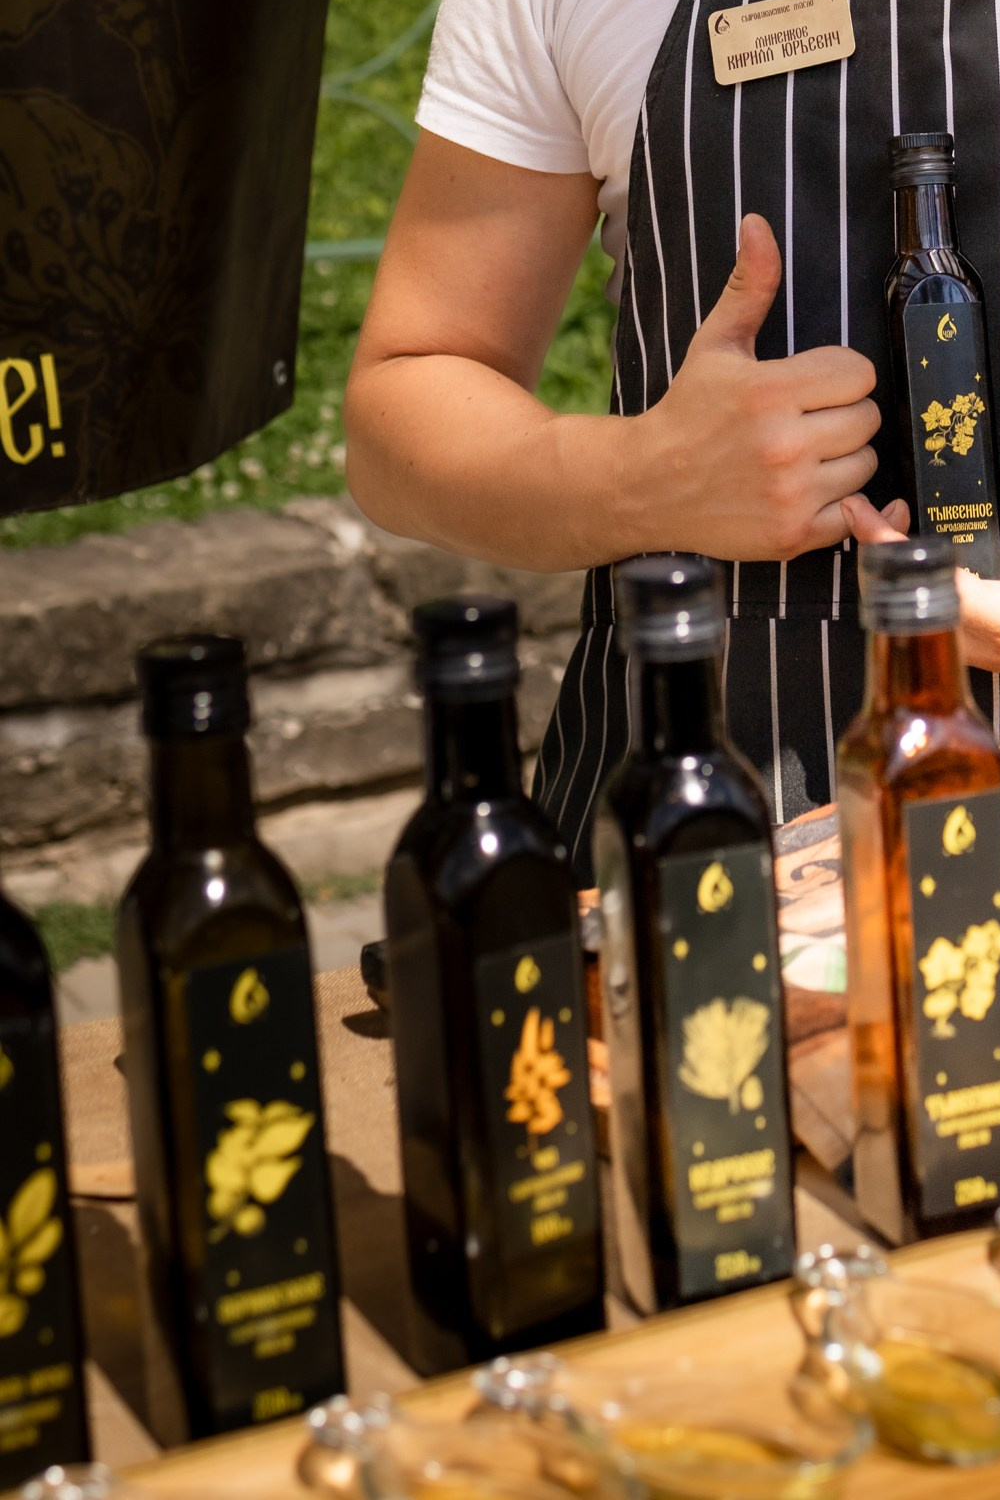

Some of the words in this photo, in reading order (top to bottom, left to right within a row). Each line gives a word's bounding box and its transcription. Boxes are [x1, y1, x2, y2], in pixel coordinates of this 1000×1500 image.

[754, 25, 809, 49] МИНЕНКОВ
[727, 47, 775, 71] КИРИЛЛ
[781, 30, 841, 58] ЮРЬЕВИЧ
[927, 502, 993, 521] ТЫКВЕННОЕ
[936, 520, 988, 533] СЫРОДАВЛЕННОЕ
[952, 533, 975, 544] МАСЛО
